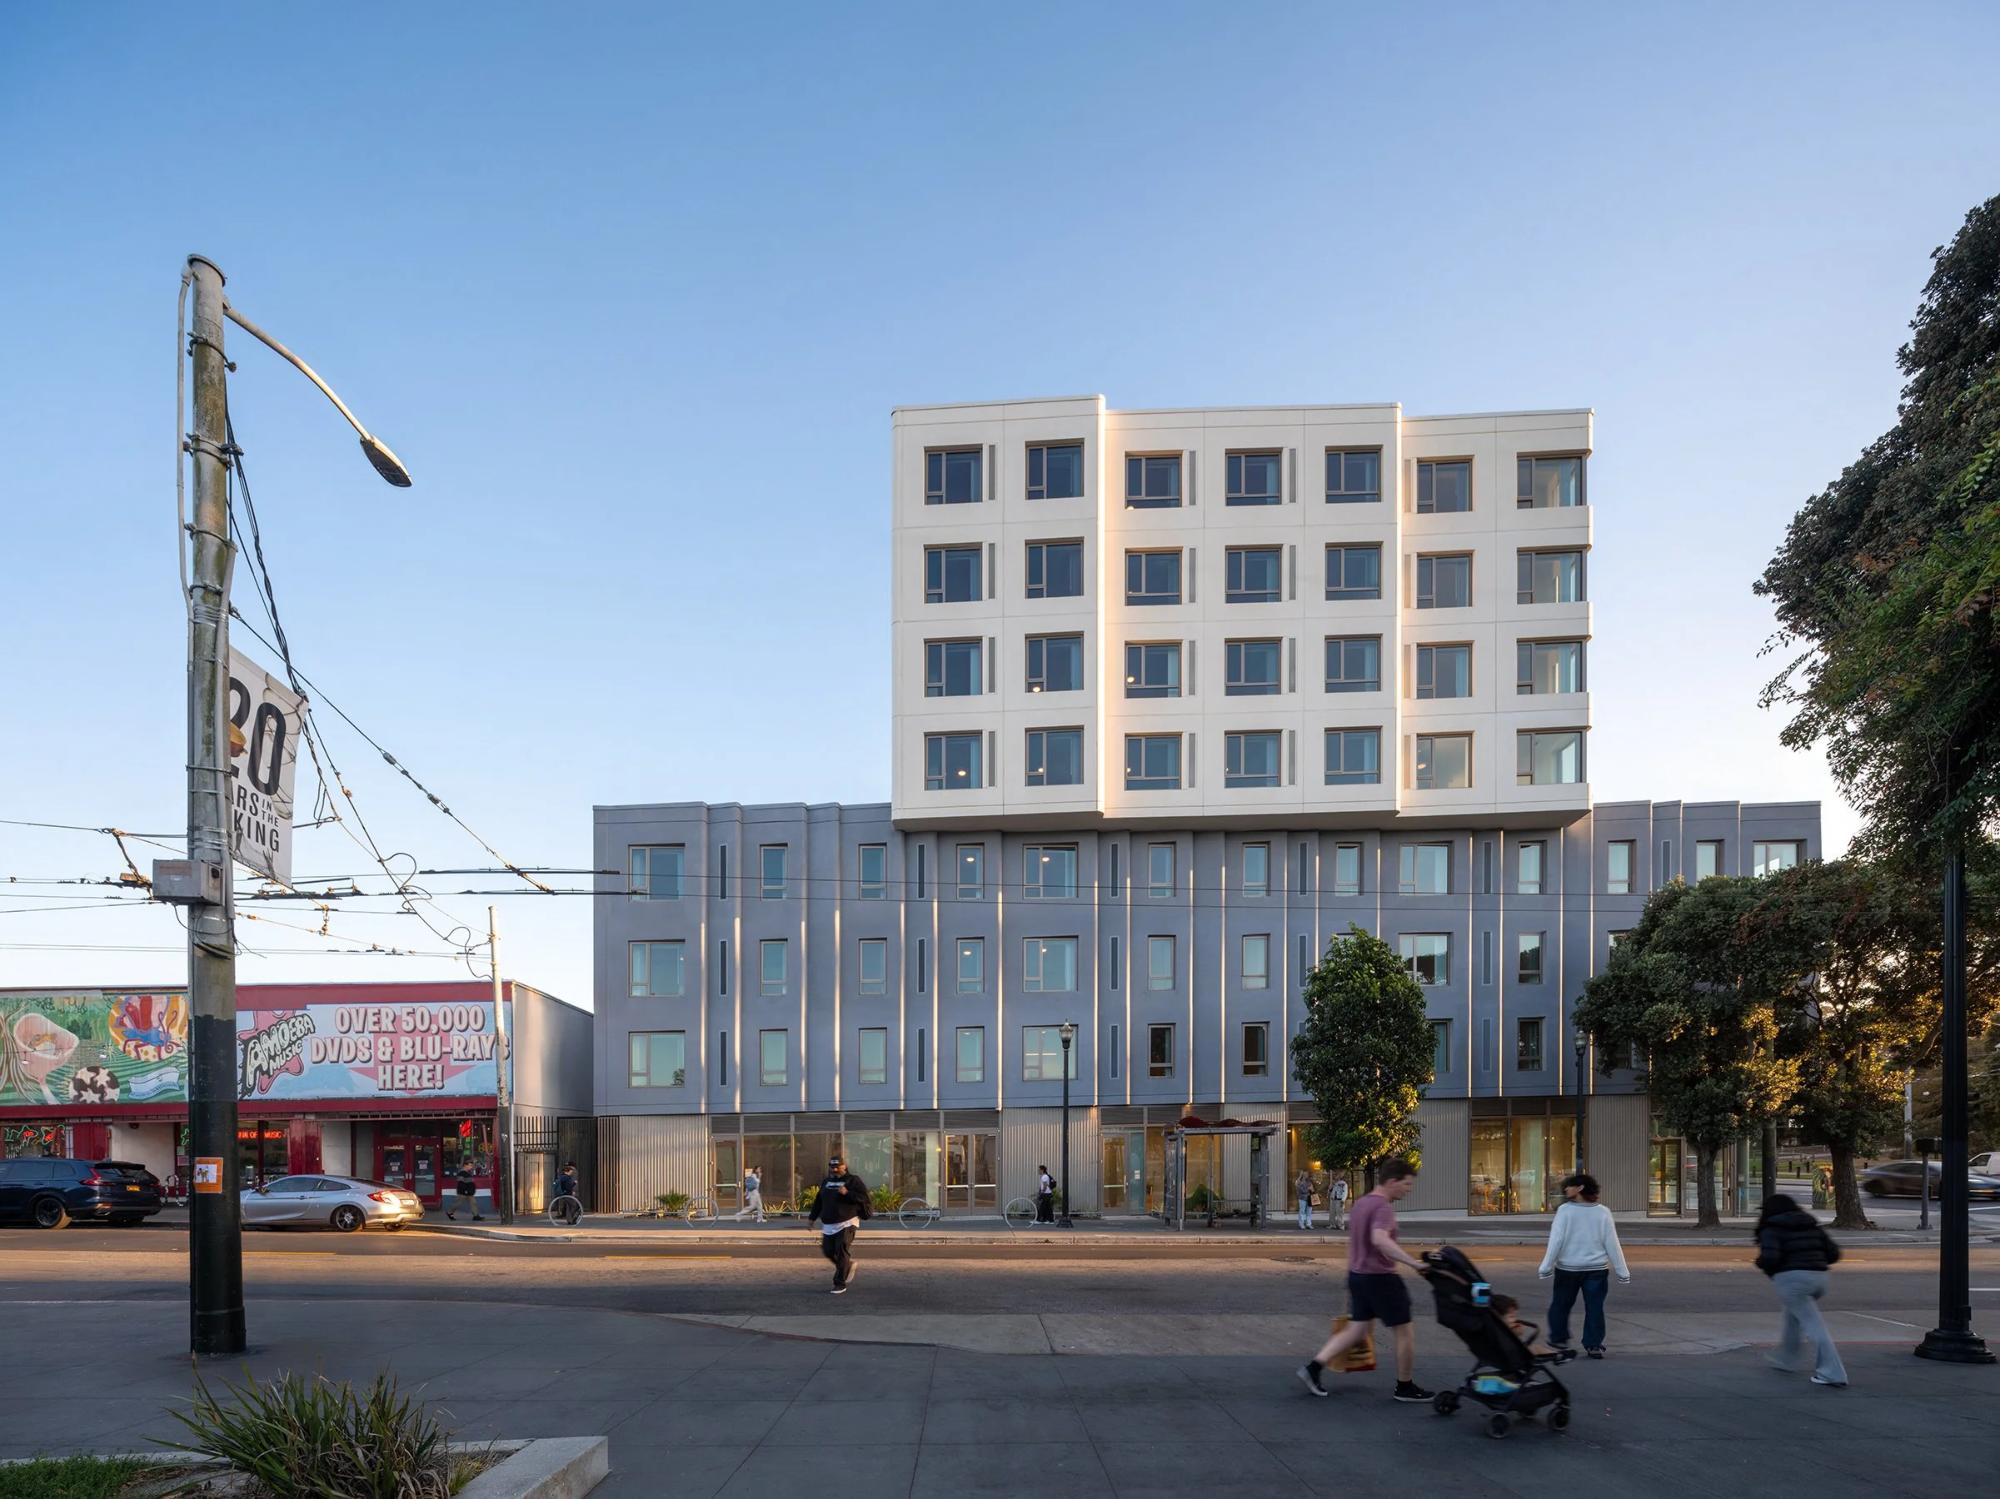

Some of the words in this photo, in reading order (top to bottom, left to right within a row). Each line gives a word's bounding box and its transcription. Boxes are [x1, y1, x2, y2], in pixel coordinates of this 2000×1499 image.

[231, 784, 259, 817] RS
[262, 799, 272, 811] IN
[234, 809, 279, 852] KING
[262, 810, 280, 828] THE
[335, 1006, 397, 1034] OVER
[402, 1004, 485, 1034] 50,000
[245, 1013, 315, 1090] AMOEBA
[269, 1040, 304, 1077] MUSIC
[311, 1034, 373, 1064] DVDS
[377, 1034, 393, 1063] &
[377, 1064, 445, 1091] HERE!
